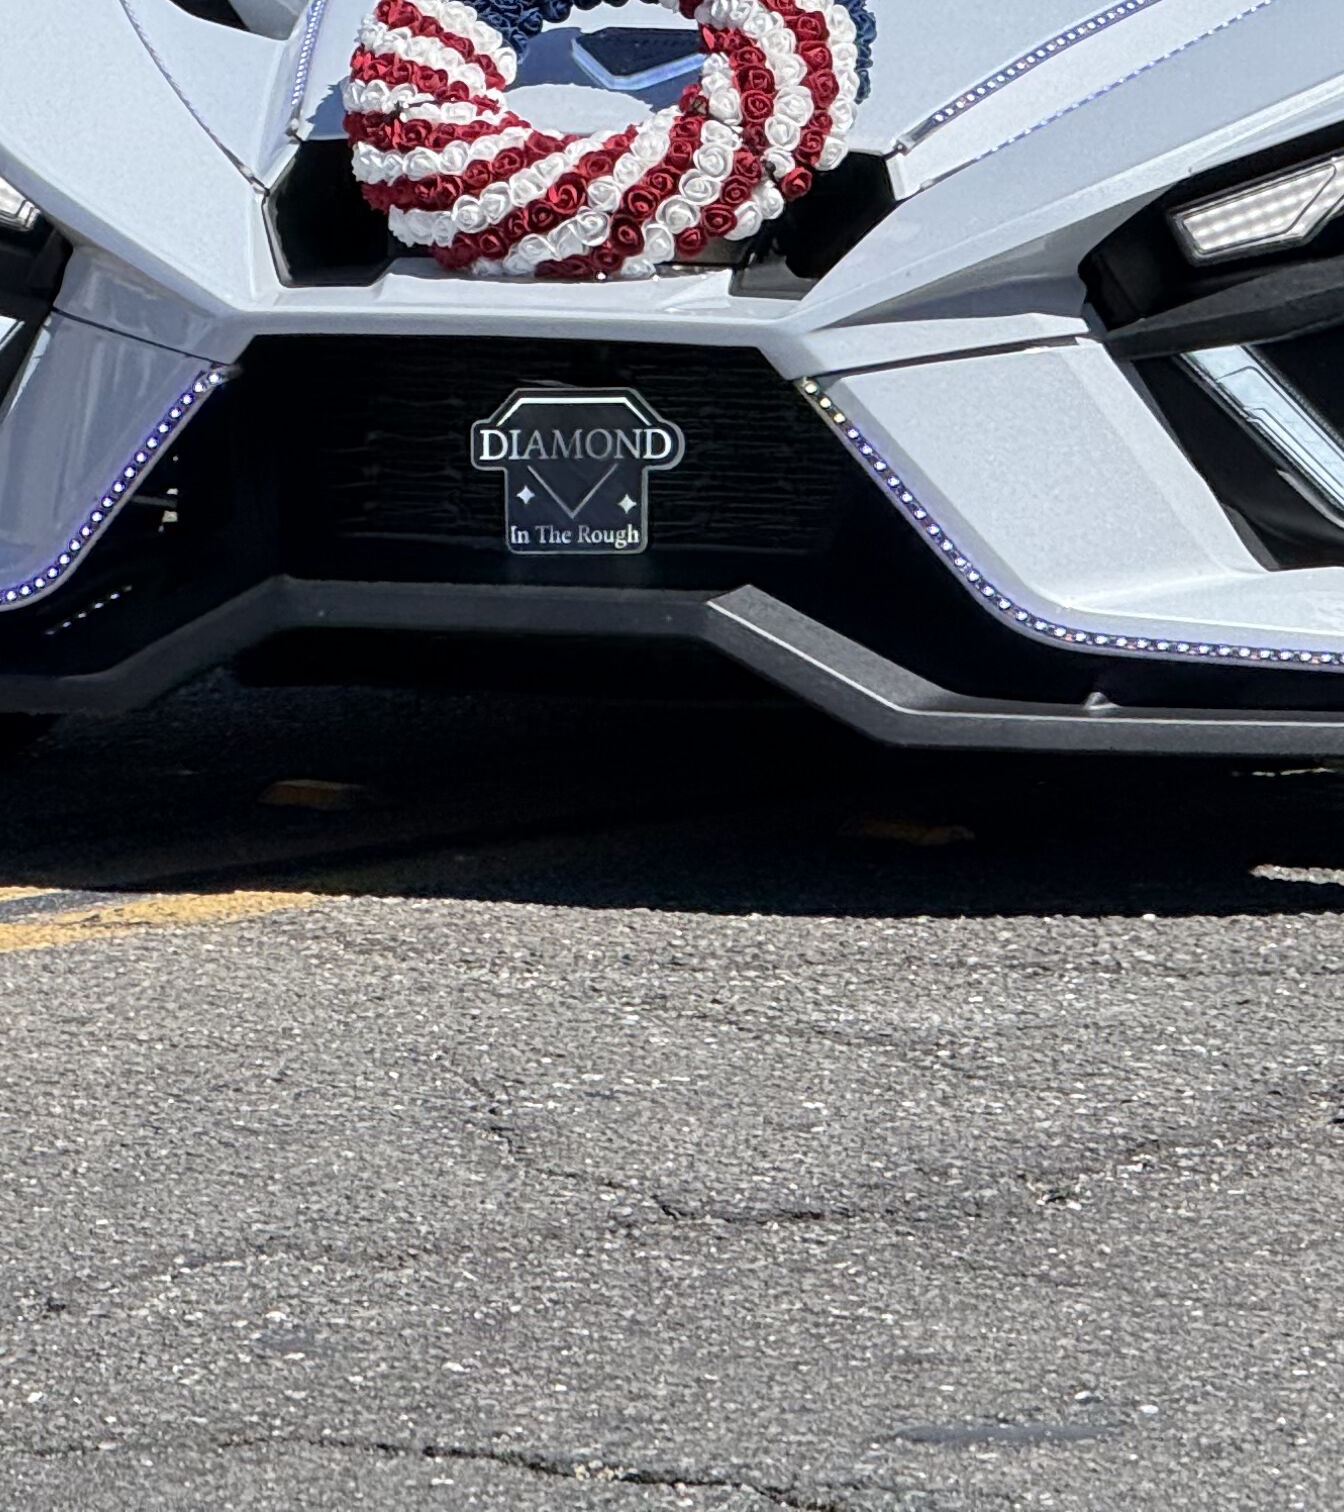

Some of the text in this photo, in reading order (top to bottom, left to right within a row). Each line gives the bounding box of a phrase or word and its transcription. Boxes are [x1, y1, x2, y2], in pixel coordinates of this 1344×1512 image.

[479, 427, 672, 461] DIAMOND
[510, 524, 640, 550] In The Rough
